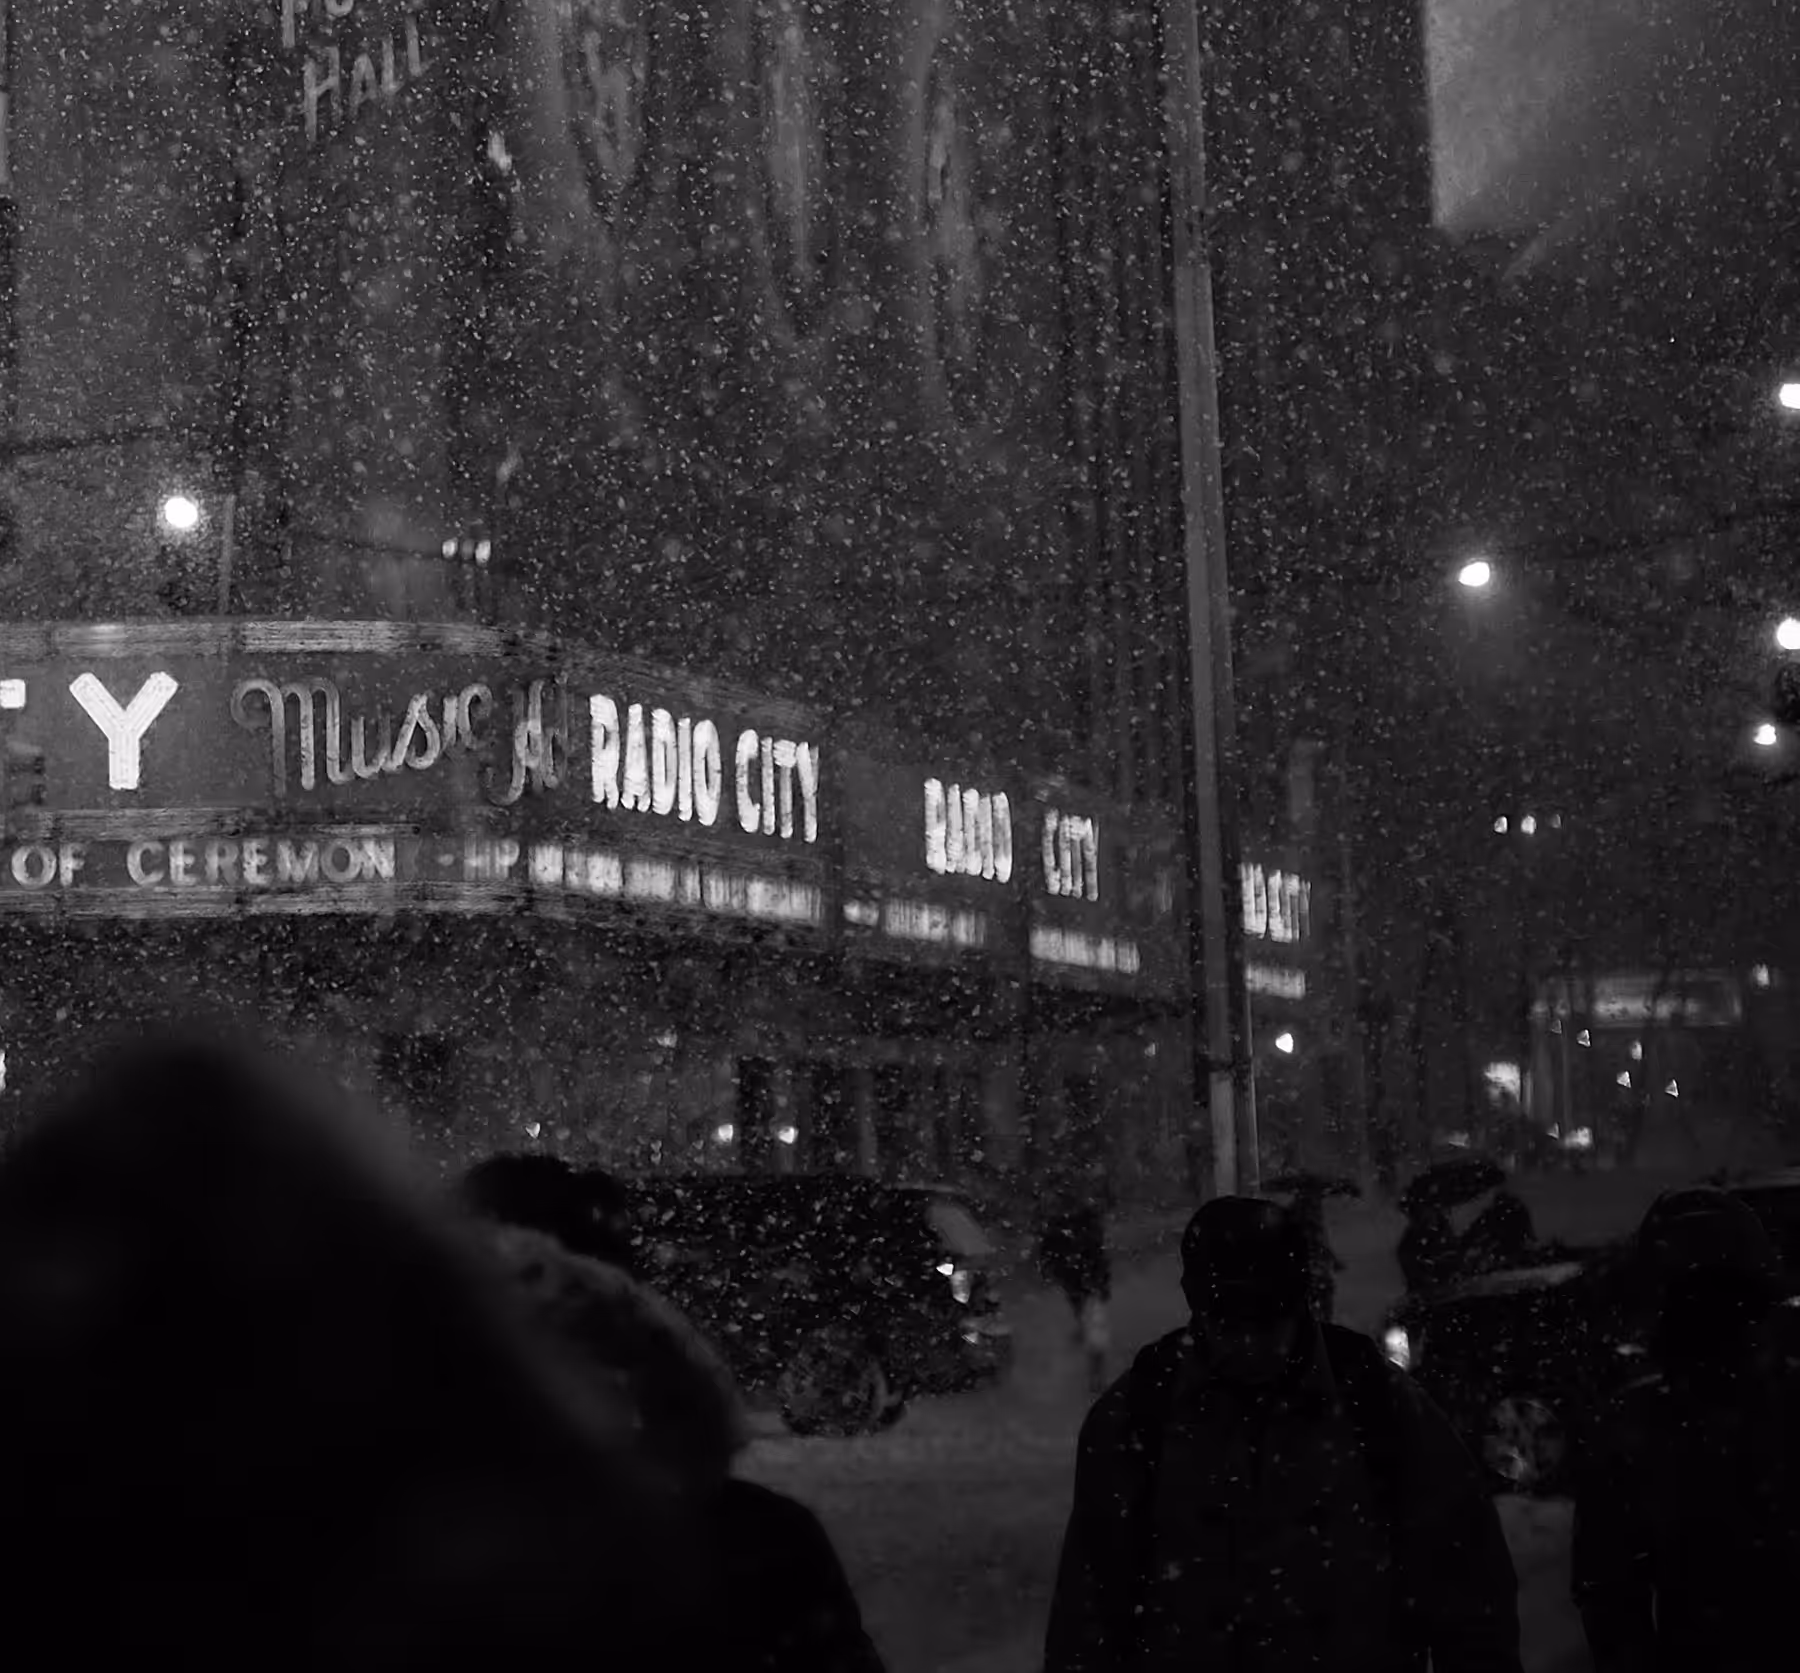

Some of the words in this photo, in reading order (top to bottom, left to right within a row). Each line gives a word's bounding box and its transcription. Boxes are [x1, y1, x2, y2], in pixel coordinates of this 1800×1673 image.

[301, 13, 436, 145] HALL
[230, 678, 493, 798] Music
[588, 694, 722, 827] RADIO
[735, 728, 820, 843] CITY
[10, 842, 87, 890] OF
